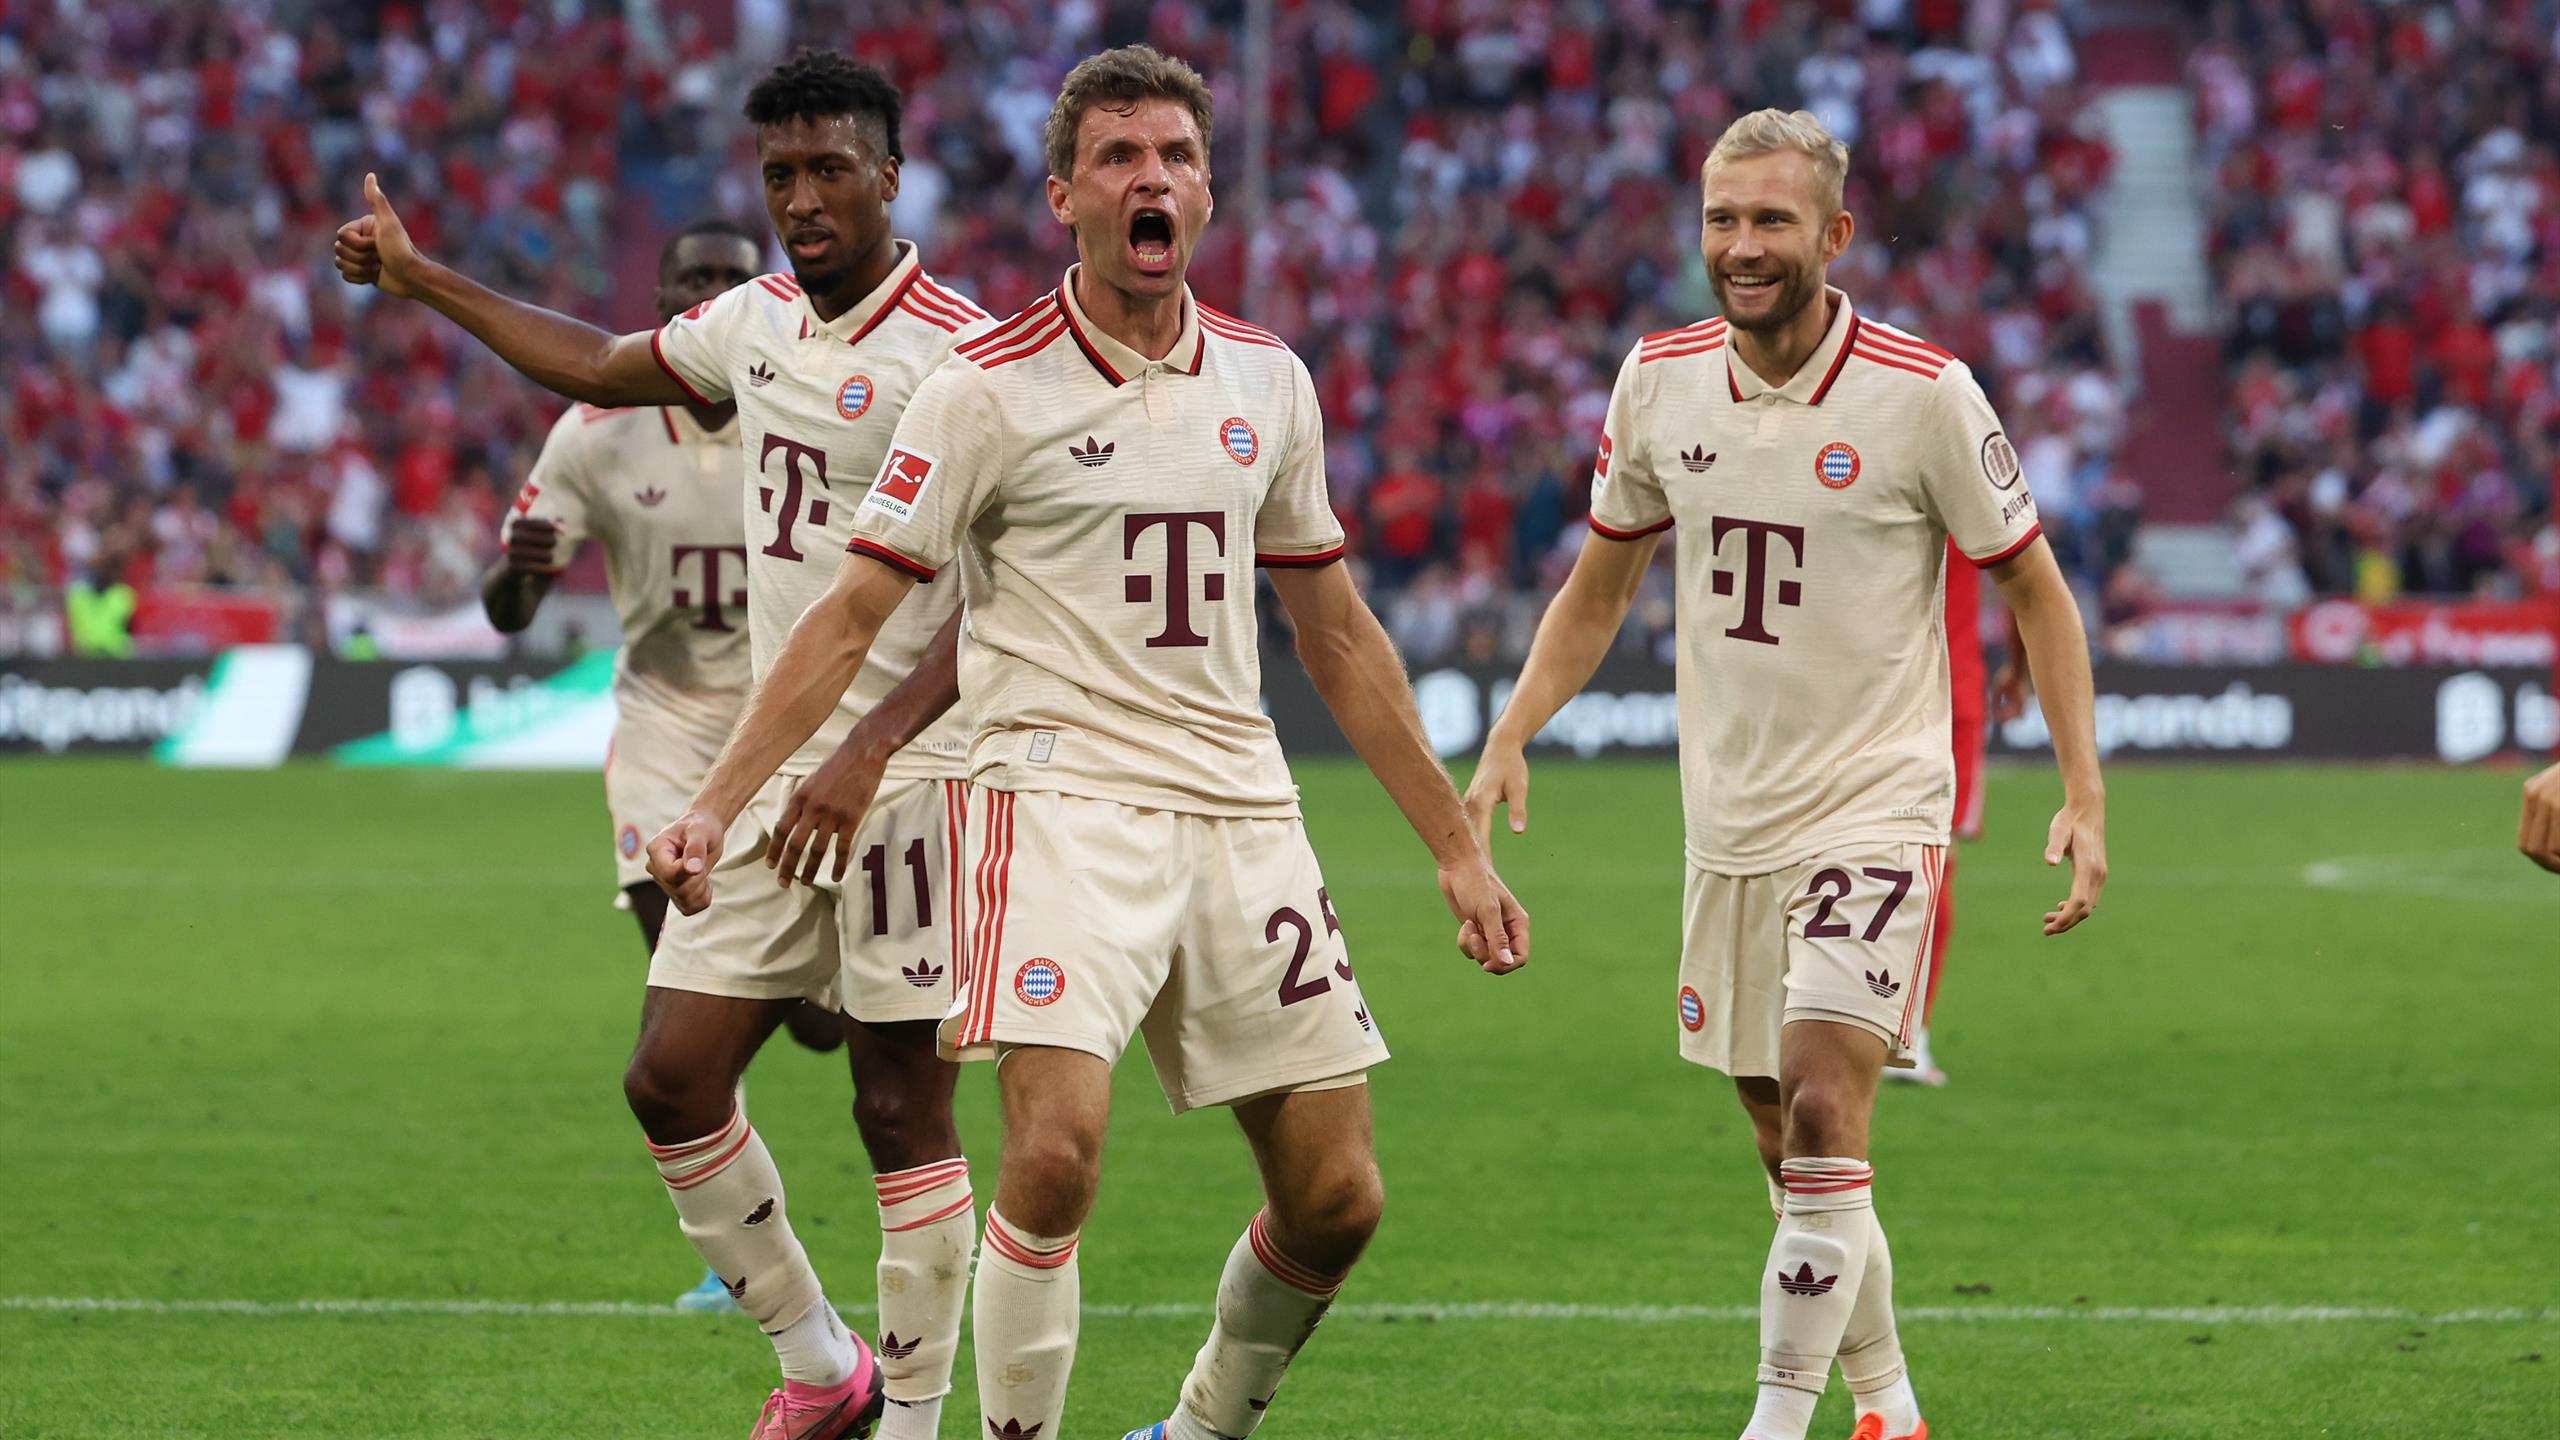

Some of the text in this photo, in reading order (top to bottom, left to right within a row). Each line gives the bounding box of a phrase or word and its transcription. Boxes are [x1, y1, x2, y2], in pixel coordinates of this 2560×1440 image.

[760, 432, 830, 563] T
[1124, 511, 1225, 648] T
[1712, 516, 1805, 646] T
[862, 837, 932, 936] 11
[1265, 886, 1354, 1008] 25
[1804, 867, 1913, 943] 27
[1034, 959, 1063, 976] BAYERN
